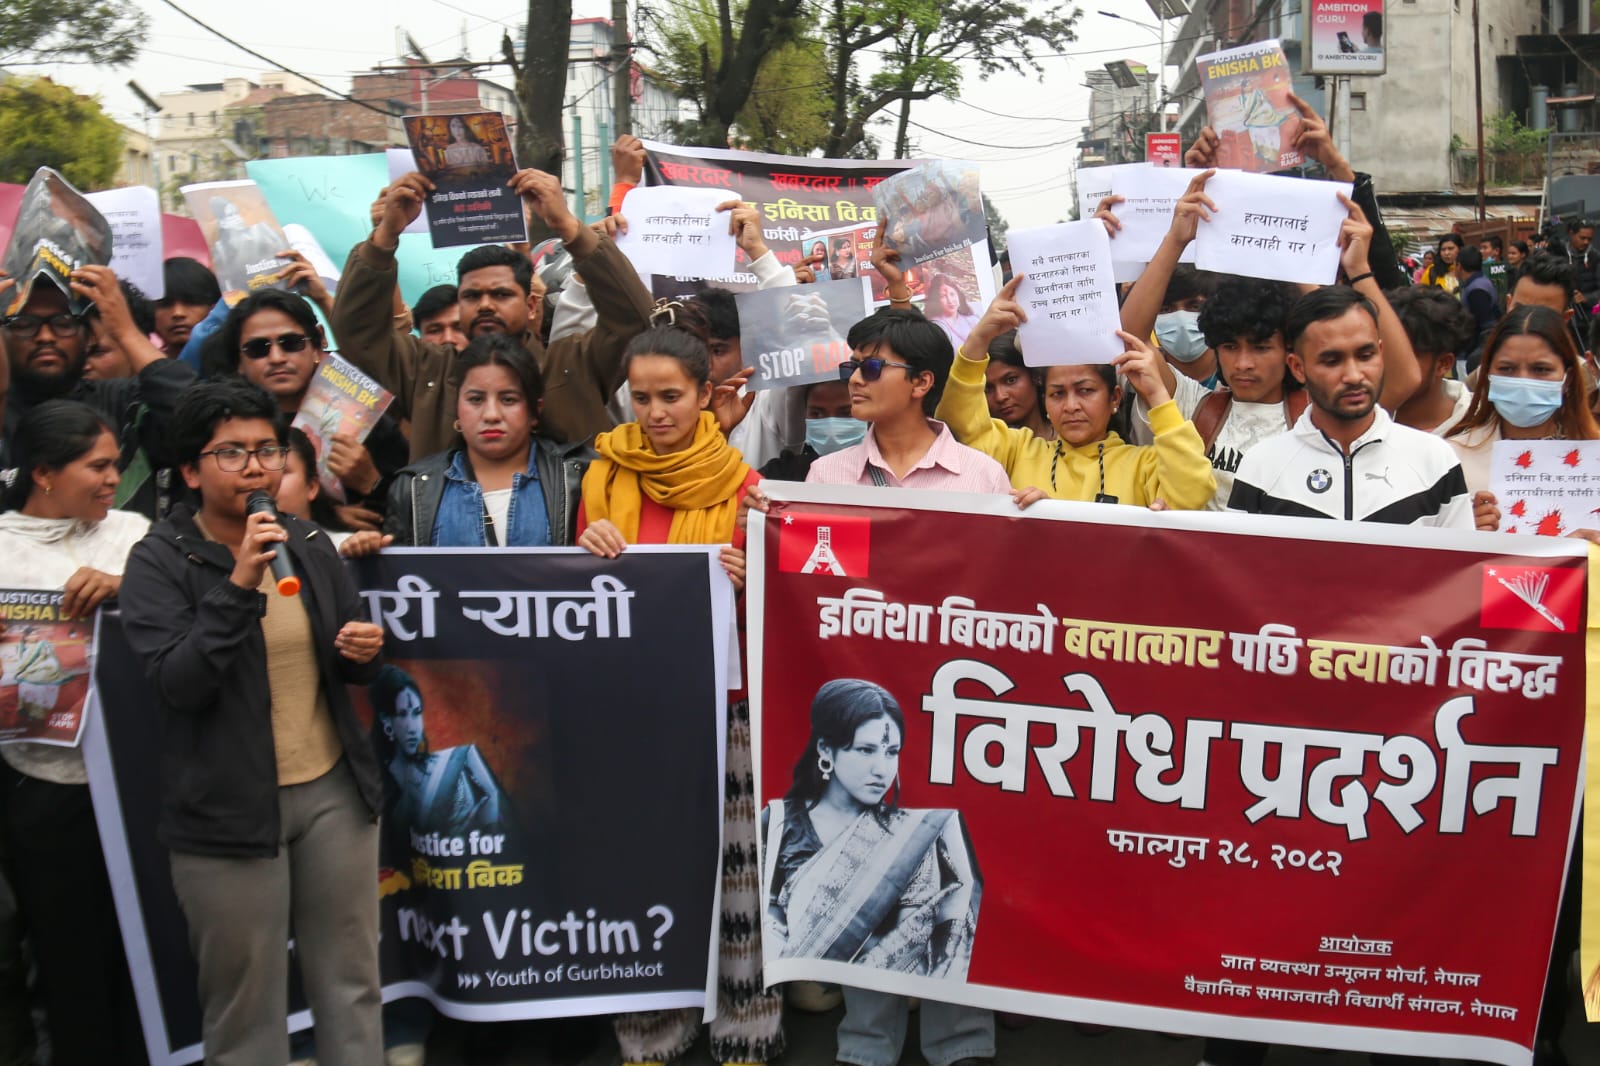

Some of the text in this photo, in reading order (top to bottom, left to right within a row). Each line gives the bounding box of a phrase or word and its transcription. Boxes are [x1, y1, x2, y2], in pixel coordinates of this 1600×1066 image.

[1317, 3, 1368, 13] AMBITION
[1317, 15, 1346, 24] GURU
[1207, 53, 1282, 80] ENISHA BK
[659, 161, 734, 188] खबरदार
[769, 172, 843, 194] खबरदार
[763, 197, 830, 223] इनिसा
[1244, 211, 1310, 232] हत्यारालाई
[688, 234, 703, 245] गर
[1287, 240, 1306, 254] गर
[422, 261, 457, 285] Just
[759, 347, 805, 381] STOP
[321, 364, 380, 411] ENISHA BK
[0, 591, 48, 605] USTICE
[0, 604, 54, 622] NISHA
[816, 587, 1564, 700] इनिशा बिकको बलात्कार पछि हत्याको विरुद्ध
[920, 657, 1560, 842] विरोध प्रदर्शन
[468, 829, 506, 856] for
[1106, 828, 1211, 869] फाल्गुन
[1270, 844, 1343, 877] २०८२
[466, 859, 524, 889] बिक
[397, 906, 470, 961] next
[1318, 934, 1394, 957] आयोजक
[485, 961, 664, 988] Youth of Gurbhakot
[1220, 953, 1257, 972] जात
[1259, 958, 1321, 977] व्यवस्था
[1323, 963, 1382, 985] उन्मूलन
[1433, 966, 1482, 988] नेपाल
[1183, 973, 1519, 1022] वैज्ञानिक समाजवादी विद्यार्थी संगठन, नेपाल
